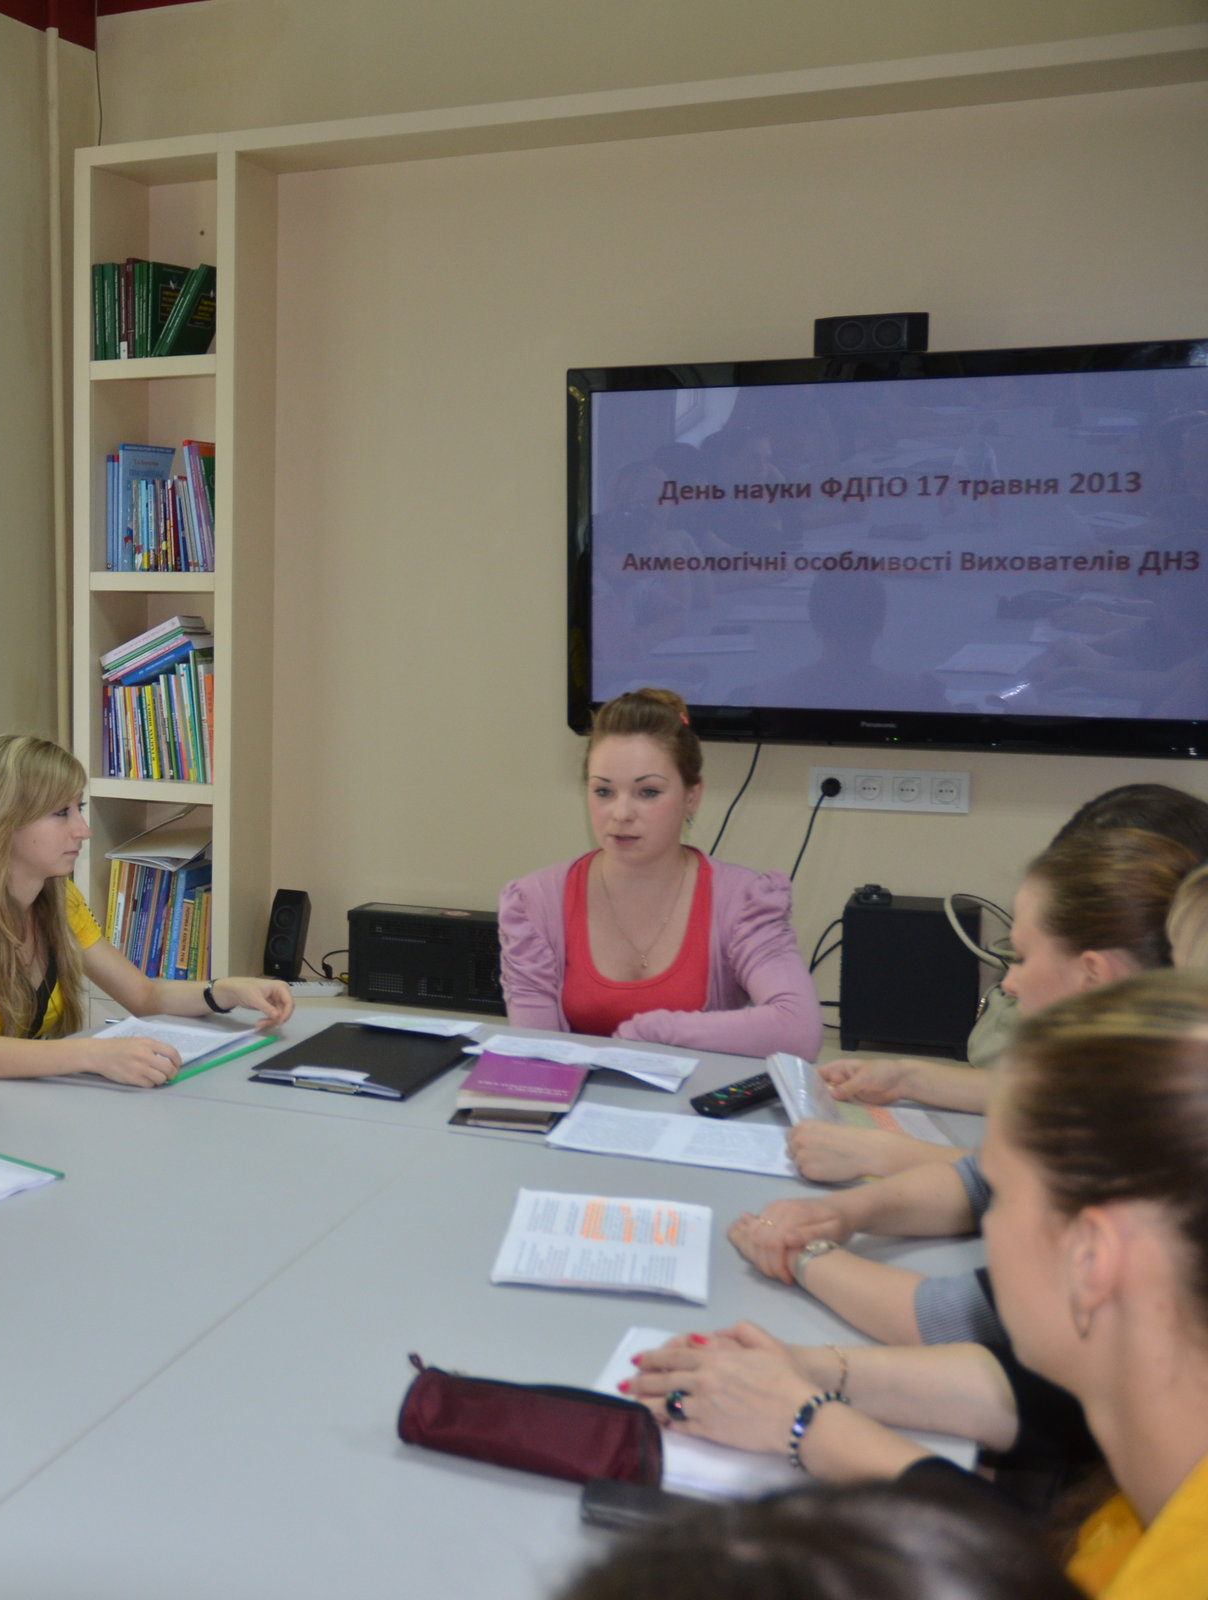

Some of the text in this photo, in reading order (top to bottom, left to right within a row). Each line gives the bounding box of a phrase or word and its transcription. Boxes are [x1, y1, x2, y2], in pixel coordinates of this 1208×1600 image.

[658, 471, 1143, 507] День науки ФДПО 17 травня 2013
[622, 549, 1200, 577] Акмеологічні особливості Вихователів ДНЗ
